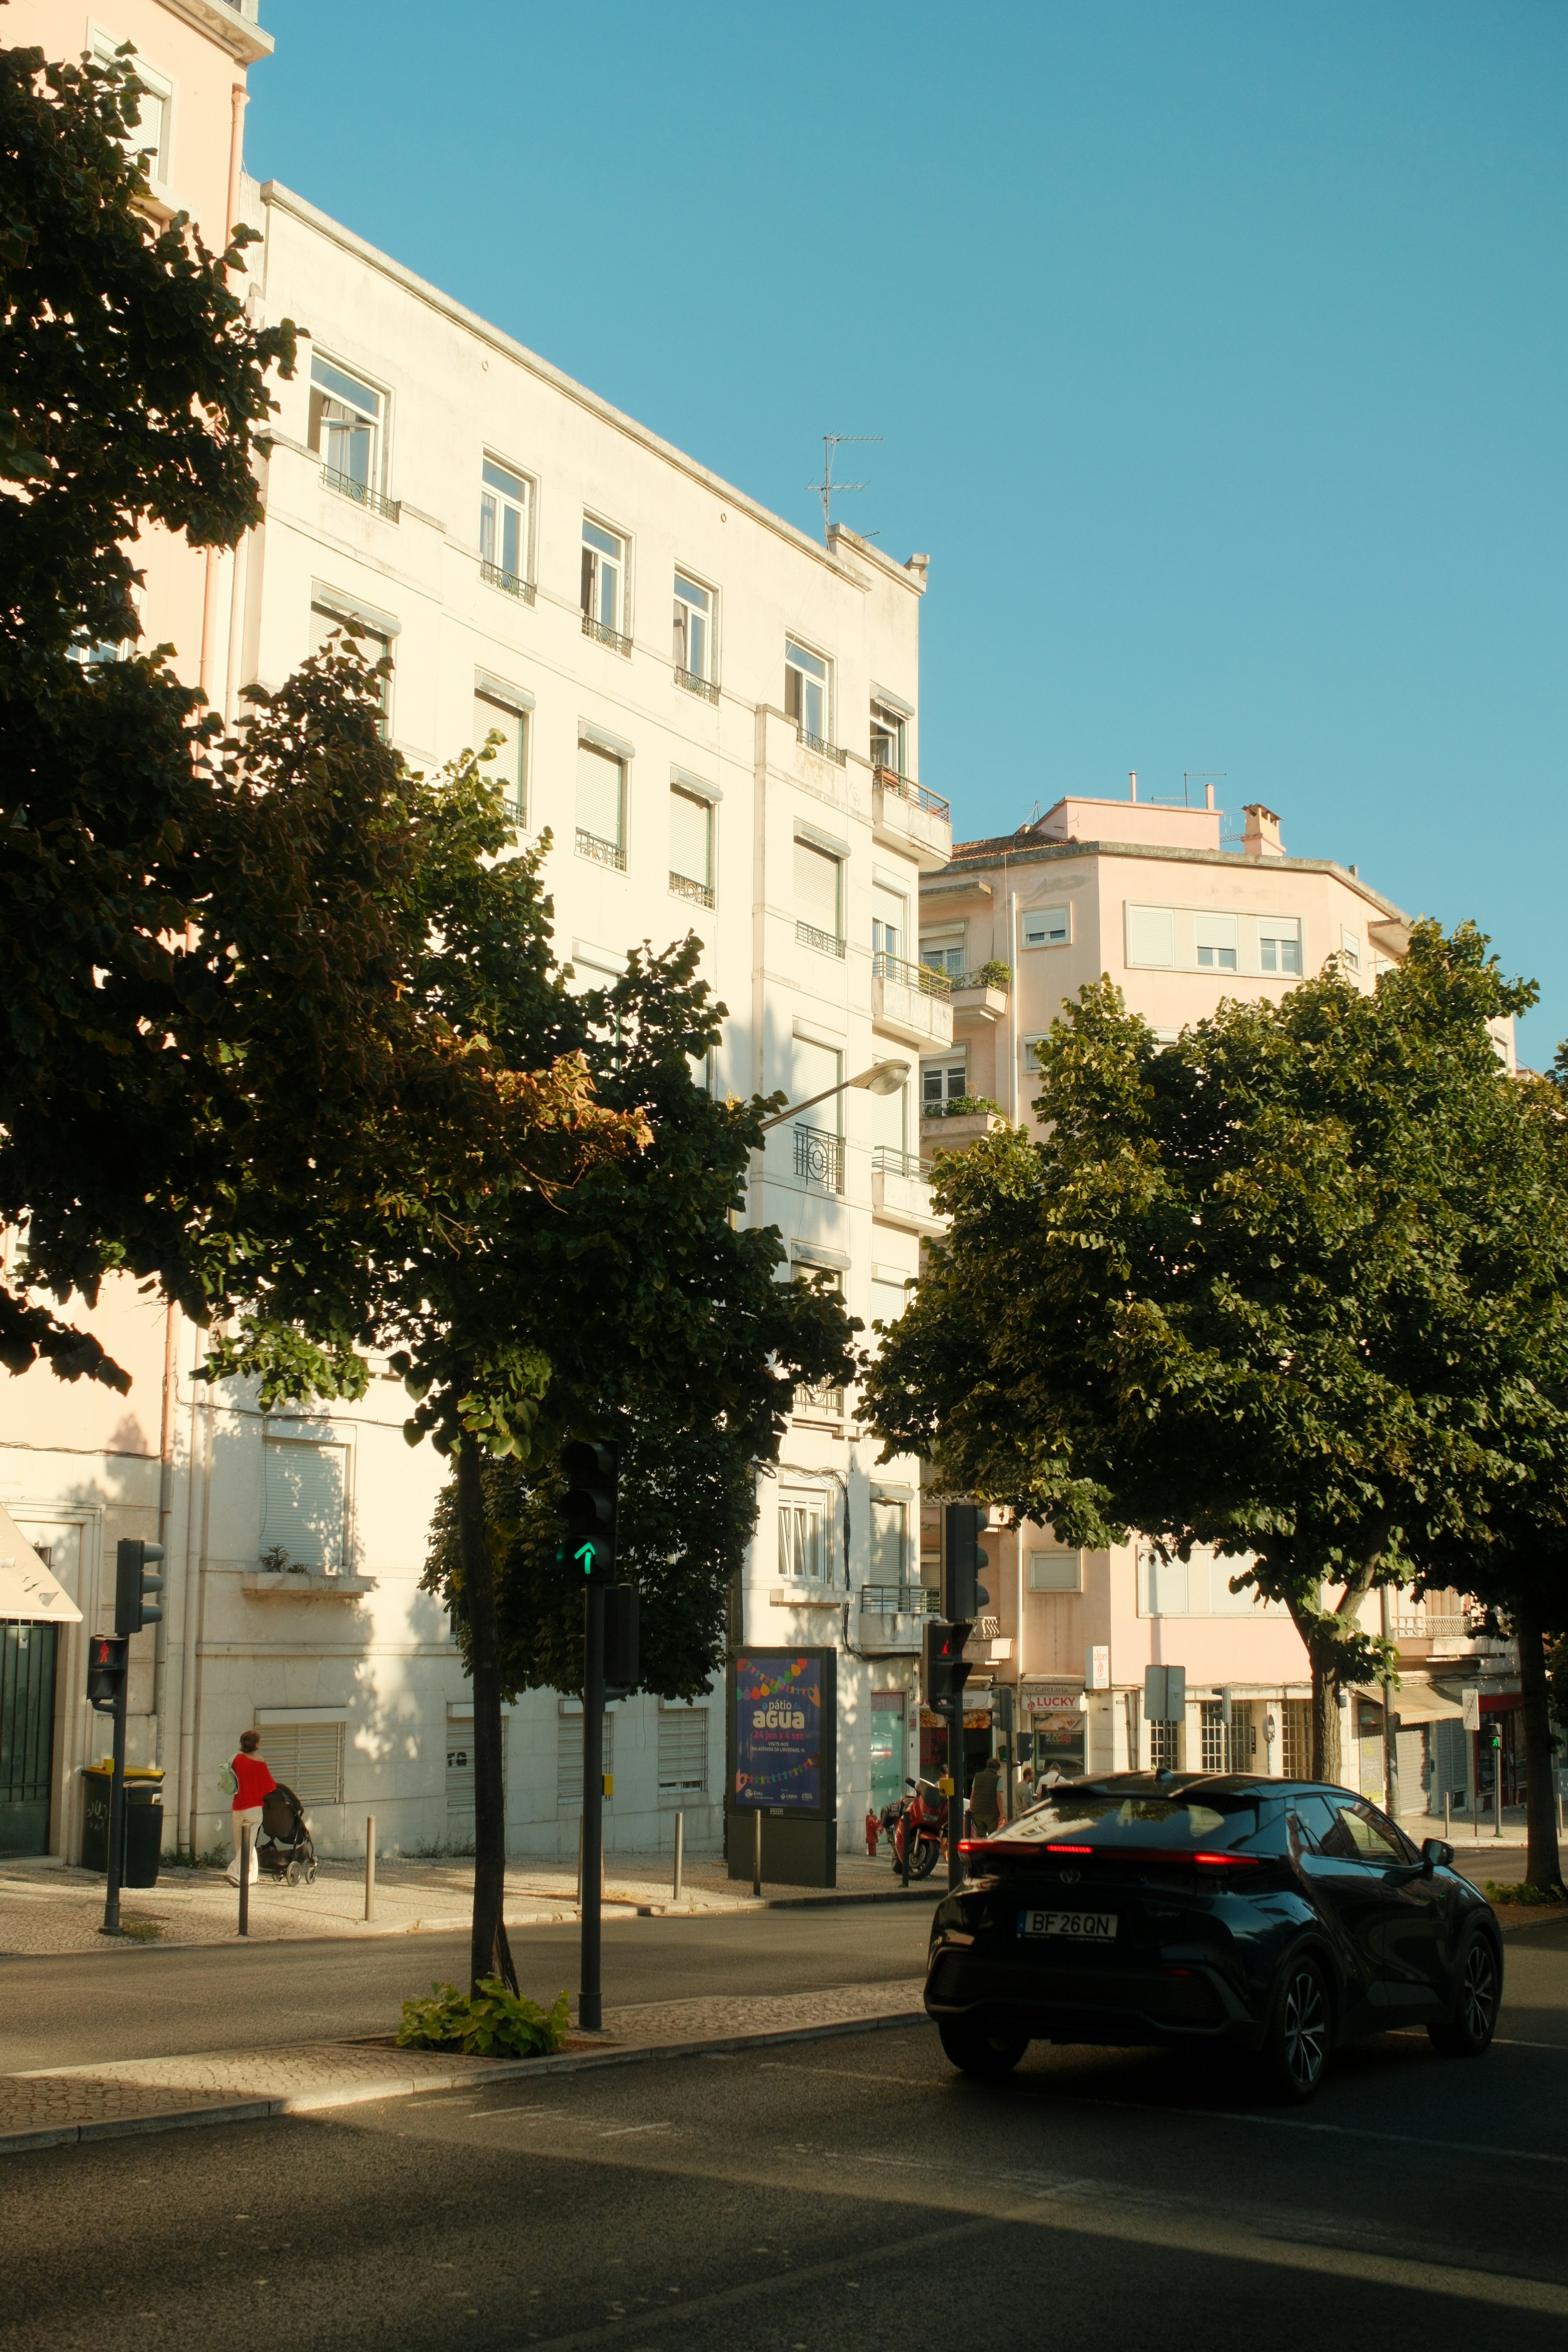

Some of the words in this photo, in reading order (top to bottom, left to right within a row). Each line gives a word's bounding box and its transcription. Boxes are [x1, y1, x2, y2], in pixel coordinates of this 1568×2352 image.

[769, 1700, 792, 1711] pátio
[1037, 1697, 1075, 1706] LUCKY
[766, 1730, 777, 1740] jun
[1033, 1913, 1058, 1931] BF
[1060, 1915, 1081, 1932] 26
[1083, 1916, 1109, 1935] QN
